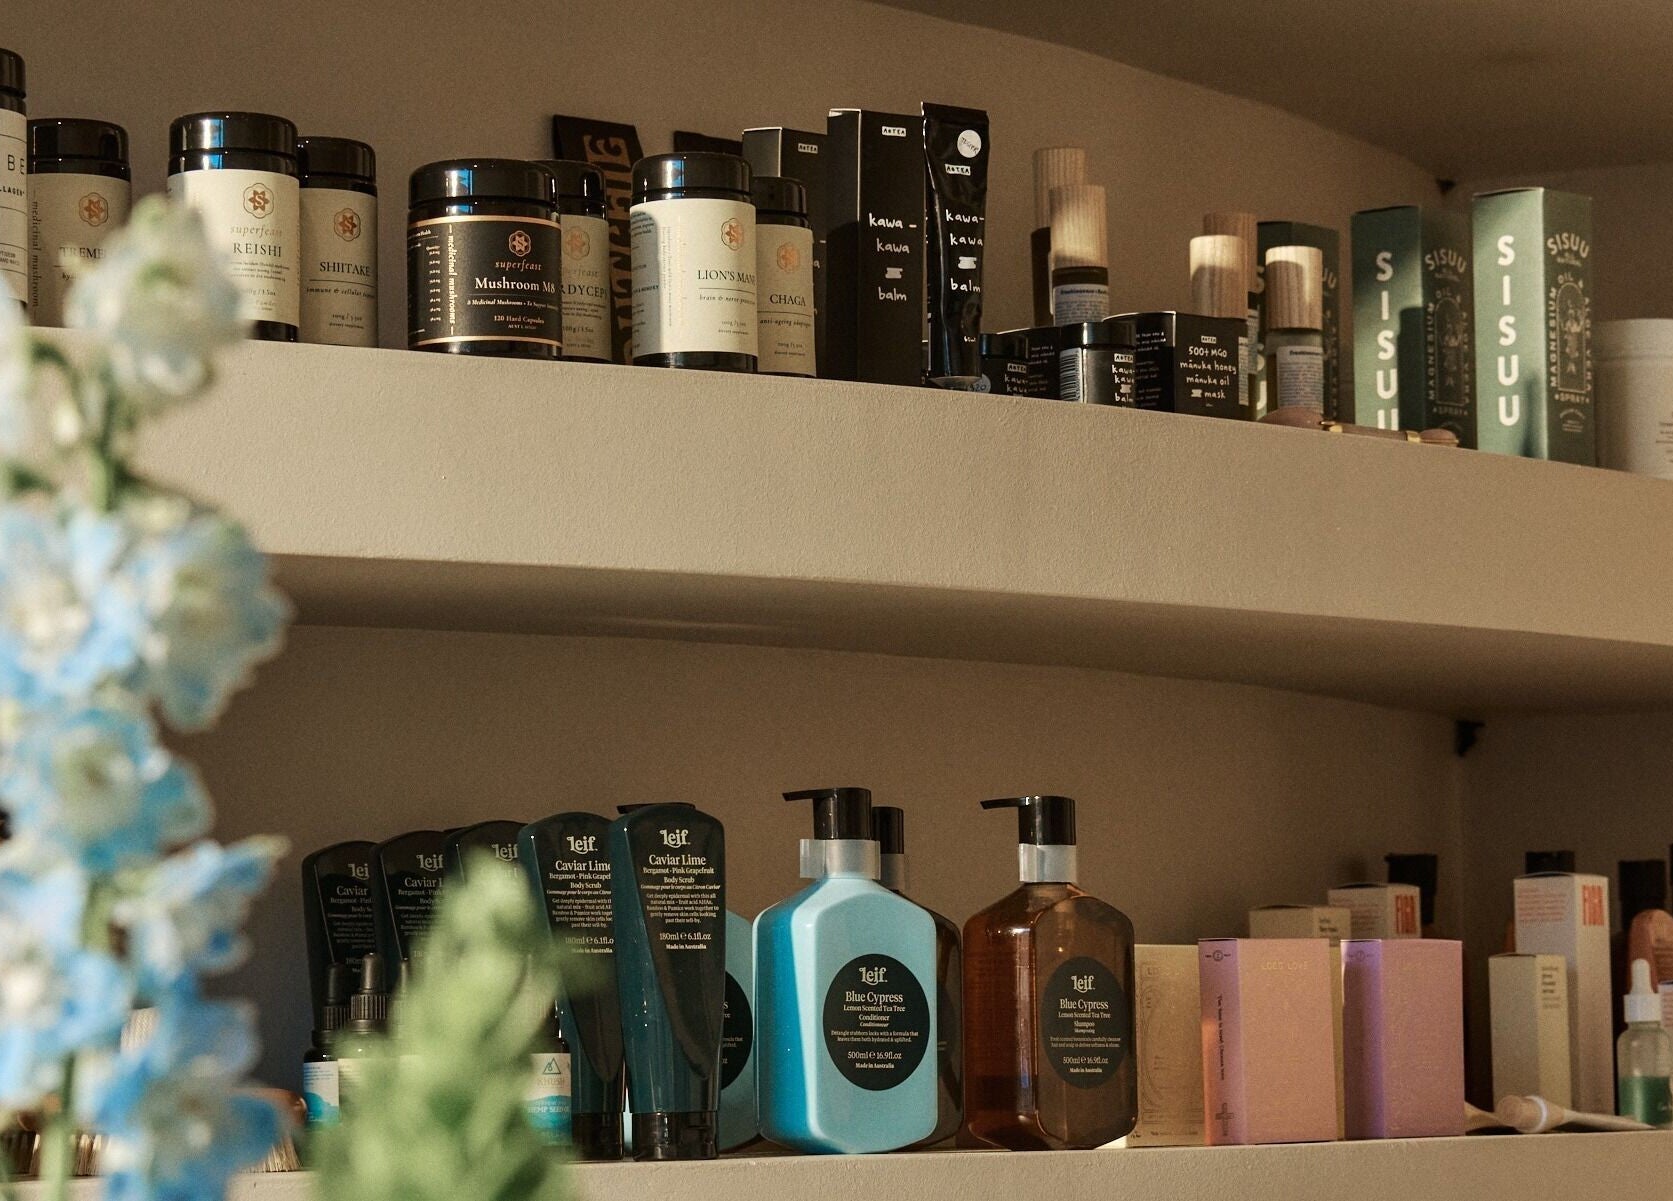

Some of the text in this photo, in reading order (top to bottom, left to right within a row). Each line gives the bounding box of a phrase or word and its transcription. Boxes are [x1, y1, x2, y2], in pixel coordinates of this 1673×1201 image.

[876, 237, 911, 254] kawa
[950, 232, 984, 247] kawa
[1547, 232, 1590, 259] SISUU
[233, 242, 282, 258] REISHI
[448, 235, 457, 276] medicinal
[495, 259, 542, 272] superfeast
[1425, 248, 1467, 275] SISUU
[319, 261, 371, 277] SHIITAKE
[698, 269, 735, 281] LION'S
[474, 276, 540, 291] Mushroom
[950, 278, 981, 293] balm
[769, 293, 806, 307] CHAGA
[878, 286, 907, 301] balm
[1497, 234, 1520, 427] SISUU
[1549, 287, 1557, 388] MAGNESIUM
[1188, 345, 1228, 358] 500+ MGO
[1214, 360, 1237, 374] honey
[1219, 375, 1230, 386] oil
[1204, 389, 1226, 399] mask
[555, 860, 587, 871] Caviar
[648, 853, 707, 866] Caviar Lime
[347, 863, 369, 880] lei
[549, 872, 593, 881] Bergamot Pink
[643, 866, 715, 875] Bergamot Pink Grapefruit
[404, 876, 437, 888] Caviar
[570, 882, 585, 890] Body
[663, 876, 678, 884] Body
[336, 885, 369, 896] Caviar
[659, 932, 712, 940] 180ml 6.1fl.oz
[845, 990, 904, 1005] Blue Cypress
[861, 1004, 883, 1012] Scented
[1059, 998, 1109, 1012] Blue Cypress
[858, 1013, 890, 1021] Conditioner
[1074, 1020, 1096, 1028] Shampoo
[847, 1051, 902, 1060] 500ml 16.9fl.oz
[1062, 1056, 1080, 1064] 500ml
